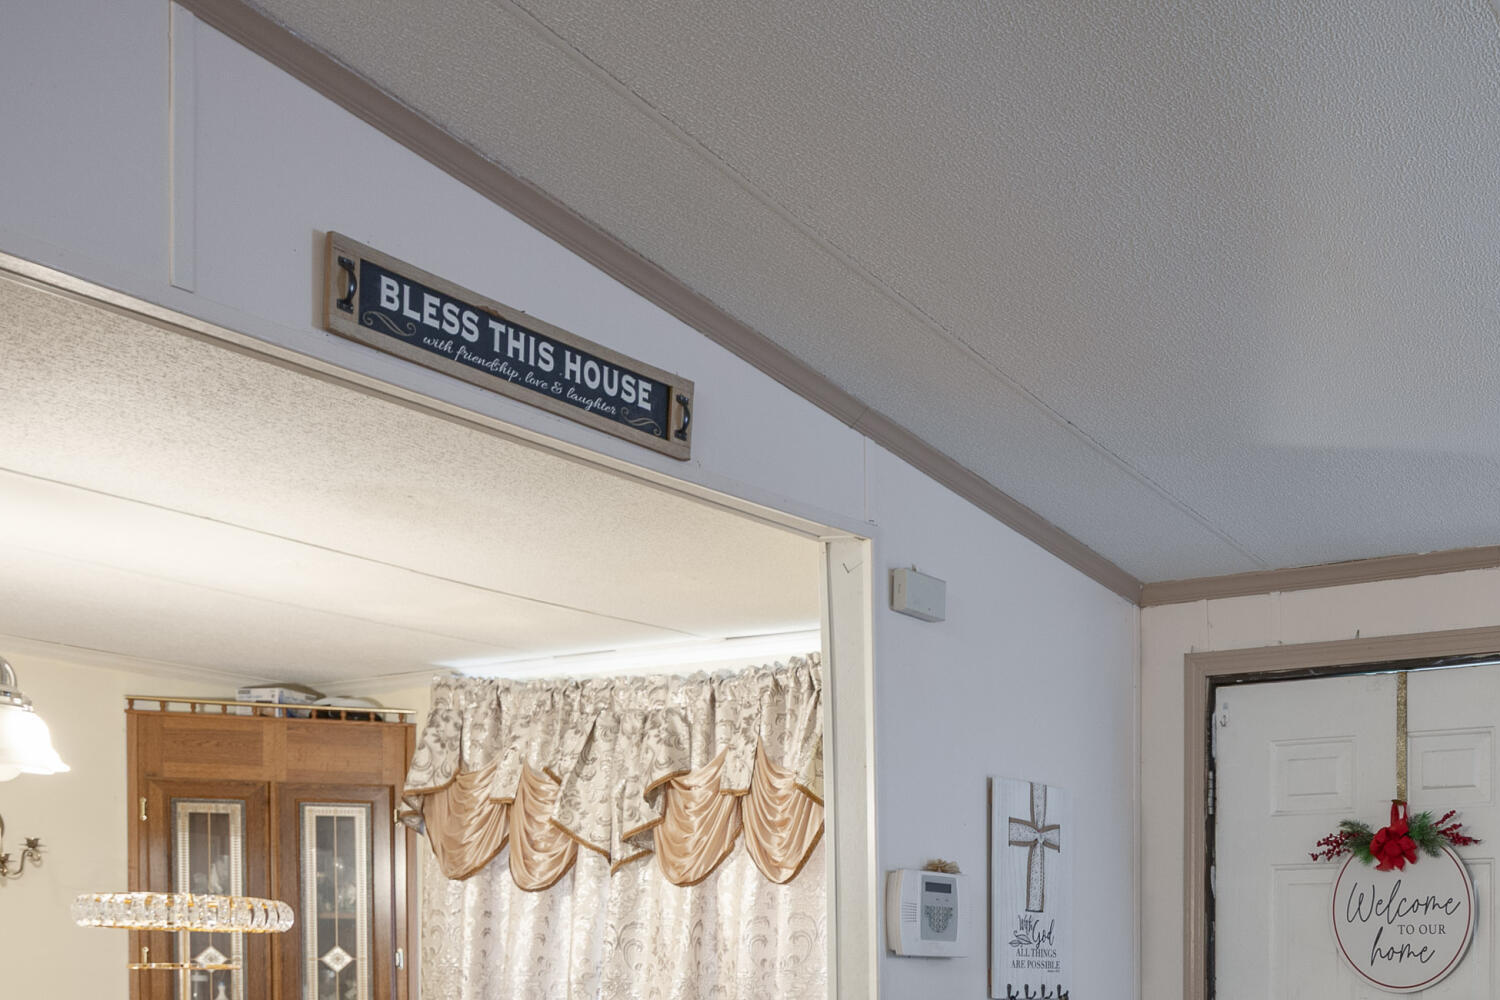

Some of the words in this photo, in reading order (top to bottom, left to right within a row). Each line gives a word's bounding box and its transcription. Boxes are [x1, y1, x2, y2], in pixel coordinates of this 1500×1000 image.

[380, 275, 479, 342] BLESS
[488, 318, 555, 372] THIS
[564, 350, 652, 411] HOUSE
[423, 336, 453, 353] with
[454, 346, 522, 381] friendship,
[525, 371, 548, 389] love
[551, 381, 562, 394] &
[566, 388, 616, 415] laughter
[1346, 879, 1461, 924] Welcome
[1018, 914, 1033, 935] With
[1032, 919, 1054, 949] God
[1371, 926, 1436, 966] home
[1397, 924, 1415, 935] TO
[1418, 924, 1446, 935] OUR
[1011, 960, 1026, 968] ARE
[1027, 960, 1061, 969] POSSIBLE
[1016, 948, 1030, 957] ALL
[1031, 948, 1056, 958] THINGS
